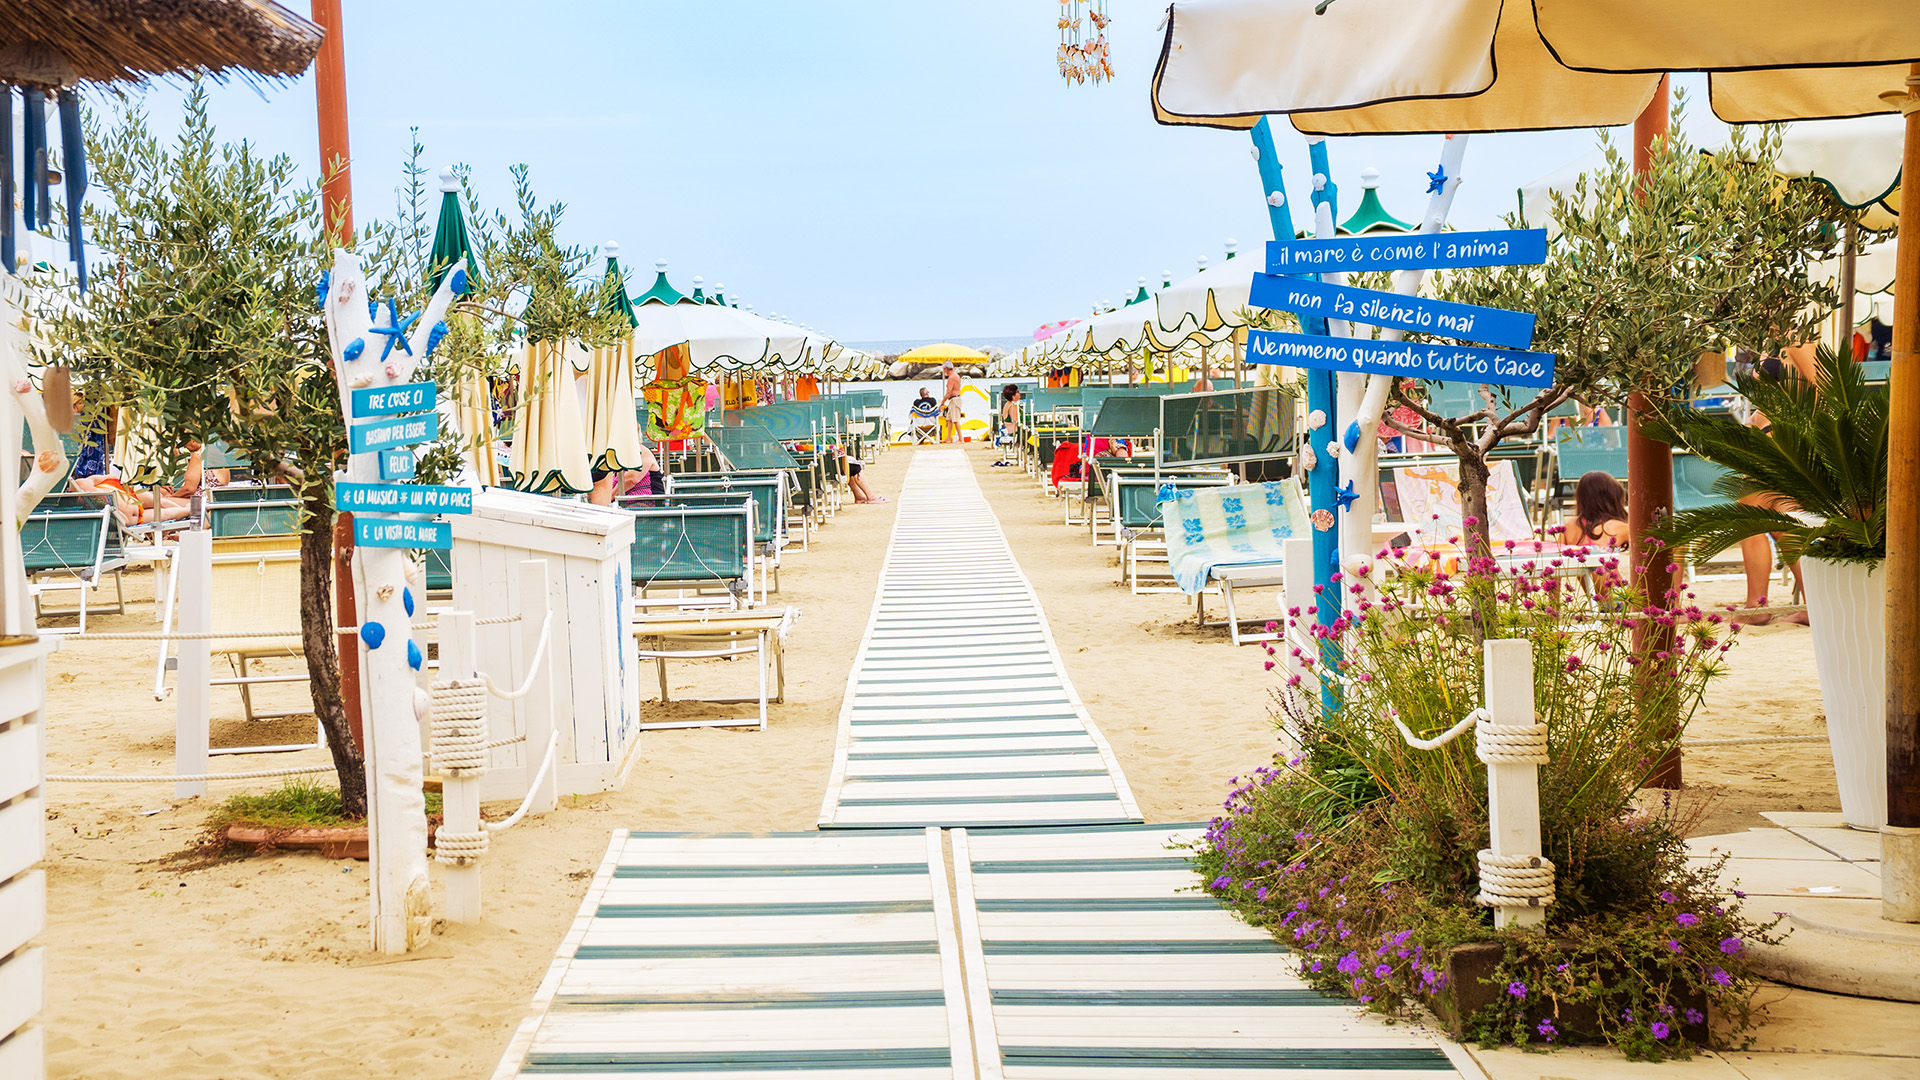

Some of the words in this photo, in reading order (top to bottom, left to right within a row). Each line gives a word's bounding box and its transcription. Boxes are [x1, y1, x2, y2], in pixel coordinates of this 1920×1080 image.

[1295, 248, 1346, 263] mare
[1352, 244, 1363, 261] è
[1371, 244, 1426, 260] come
[1288, 292, 1321, 308] non
[1334, 294, 1354, 315] fa
[1360, 300, 1431, 326] silenzio
[1438, 314, 1474, 333] mai
[1253, 336, 1347, 361] Nemmeno
[1352, 347, 1422, 368] quando
[1427, 350, 1488, 373] tutto
[1494, 355, 1545, 377] tace
[369, 394, 384, 409] TRE
[414, 390, 423, 404] CI
[392, 425, 404, 440] PER
[405, 422, 426, 438] ESSERE
[354, 490, 364, 504] LA
[367, 490, 398, 504] MUSICA
[411, 491, 422, 505] UN
[439, 493, 448, 505] DI
[451, 493, 471, 507] PACE
[363, 525, 368, 539] E
[374, 526, 383, 540] LA
[385, 525, 402, 540] VISTA
[404, 527, 416, 541] DEL
[419, 527, 437, 542] MARE
